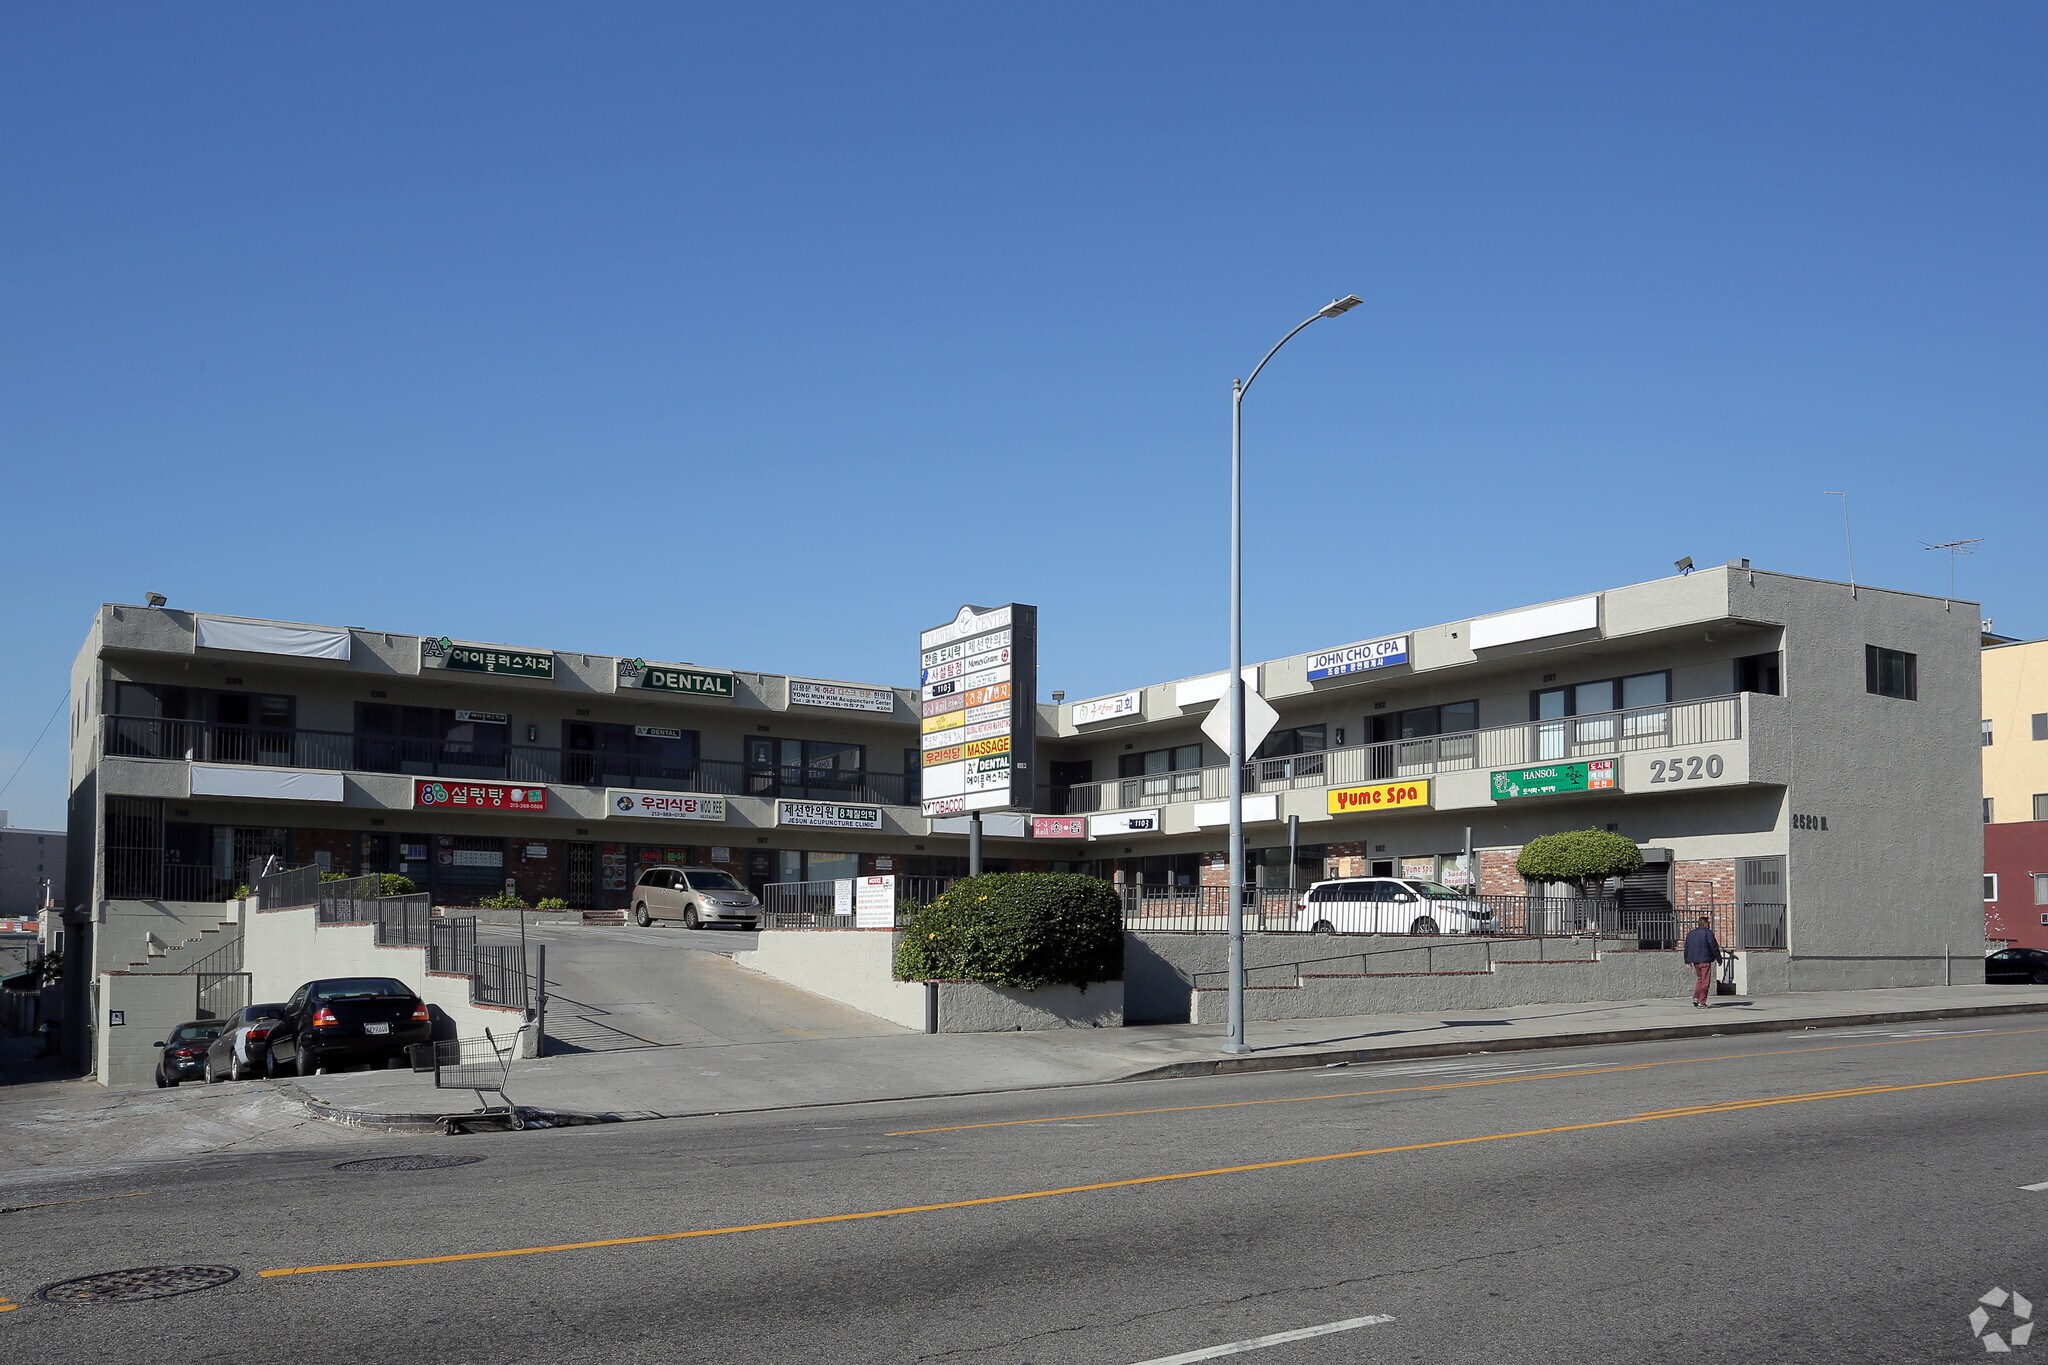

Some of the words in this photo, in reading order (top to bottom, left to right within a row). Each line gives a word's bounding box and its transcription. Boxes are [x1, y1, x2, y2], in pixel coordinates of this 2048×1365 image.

[976, 609, 1009, 631] CENTER
[967, 631, 1010, 653] 제선한의원
[453, 650, 550, 672] 에이플러스치과
[941, 645, 961, 661] 도시락
[1314, 652, 1344, 668] JOHN
[1346, 647, 1374, 661] CHO,
[1376, 641, 1399, 656] CPA
[968, 655, 998, 668] MoneyGram
[932, 661, 962, 681] 사설탐정
[1542, 673, 1556, 683] 201
[652, 671, 727, 693] DENTAL
[839, 697, 874, 705] Acupuncture
[1115, 696, 1133, 713] 교회
[651, 729, 677, 737] DENTAL
[926, 747, 961, 763] 우리식당
[967, 738, 1009, 757] MASSAGE
[979, 757, 1010, 771] DENTAL
[1590, 761, 1611, 770] 도시락
[1650, 754, 1724, 783] 2520
[1523, 769, 1558, 780] HANSOL
[1594, 780, 1608, 788] 반찬
[422, 783, 448, 804] 88
[451, 786, 504, 806] 설렁탕
[1338, 790, 1381, 809] Yume
[1387, 786, 1418, 804] Spa
[641, 796, 698, 812] 우리식당
[785, 804, 834, 819] 제선한의원
[932, 798, 964, 814] TOBACCO
[787, 817, 808, 825] JESUN
[809, 819, 854, 827] ACUPUNCTURE
[1134, 820, 1150, 829] 1103
[1793, 813, 1818, 831] 2520
[1375, 845, 1386, 853] 102
[1405, 867, 1421, 875] Yume
[1422, 865, 1432, 874] Spa
